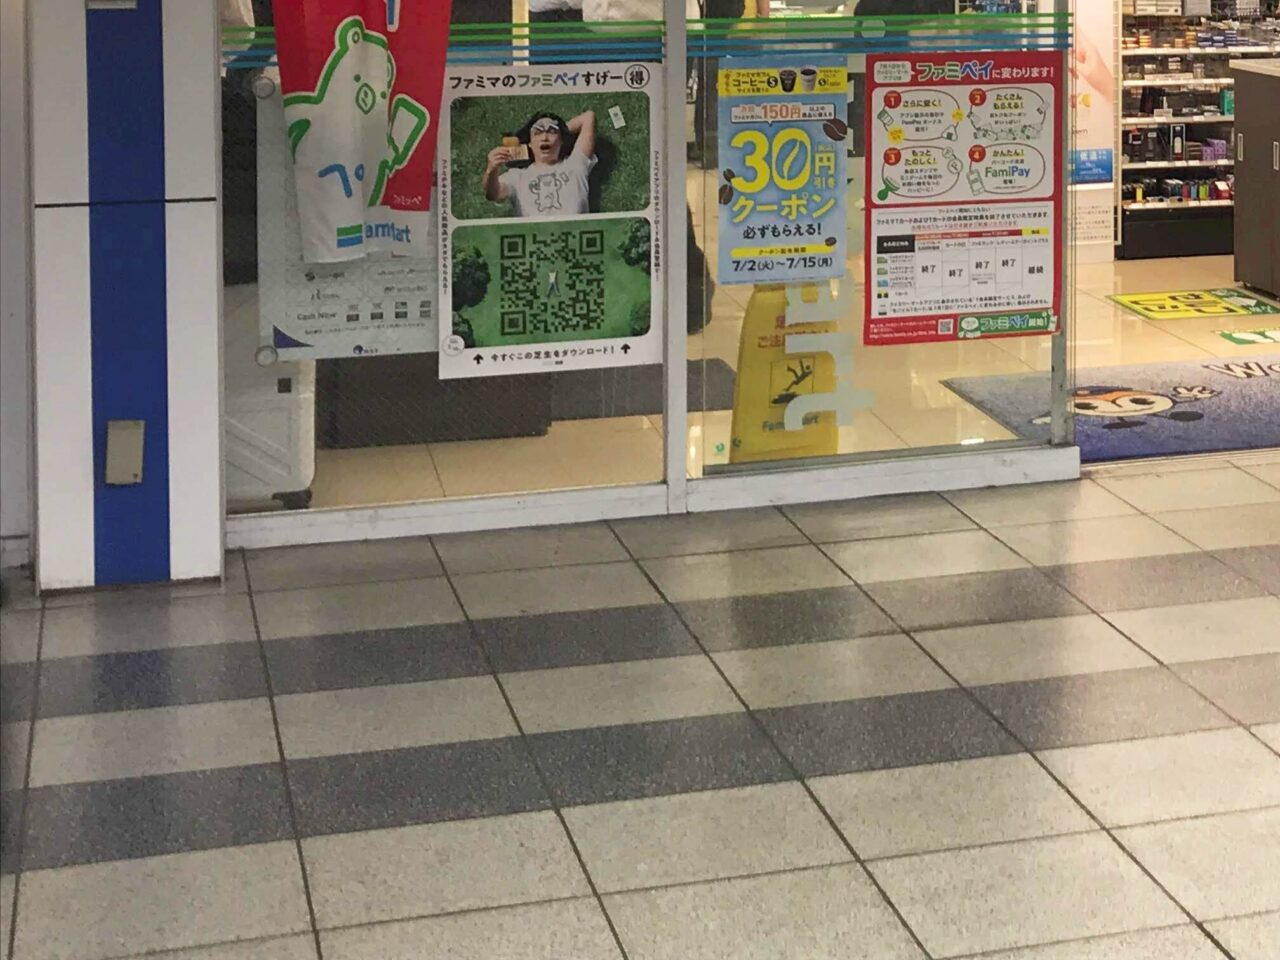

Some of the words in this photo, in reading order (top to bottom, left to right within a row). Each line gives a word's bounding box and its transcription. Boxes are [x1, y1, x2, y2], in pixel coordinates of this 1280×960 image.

[449, 69, 622, 89] ファミマのファミペイすげー
[733, 78, 765, 88] コーヒー
[761, 104, 800, 120] 150円
[984, 166, 1031, 178] FamiPay
[732, 192, 836, 224] クーポン
[743, 223, 822, 239] 必ずもらえる!
